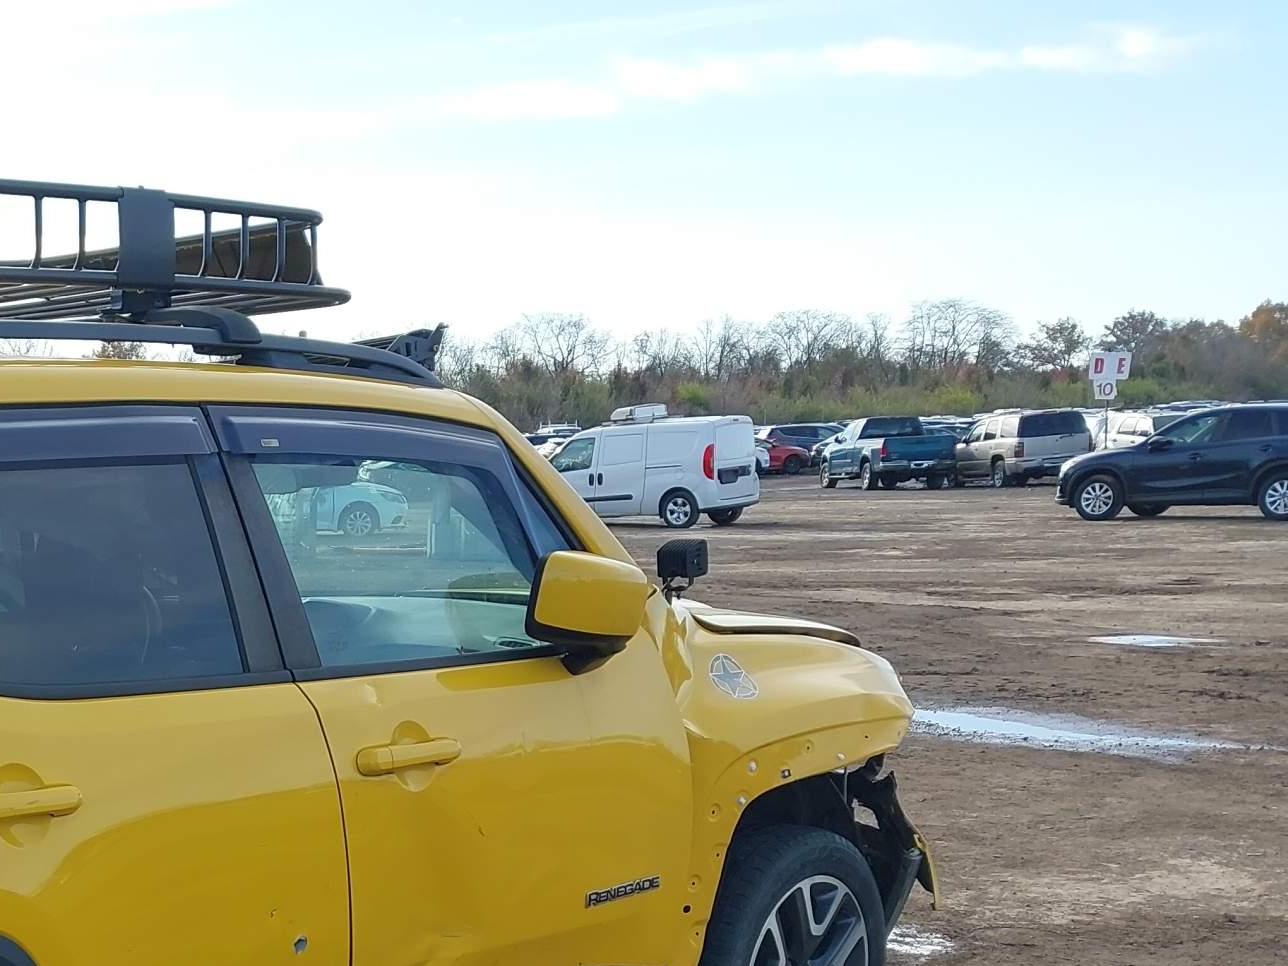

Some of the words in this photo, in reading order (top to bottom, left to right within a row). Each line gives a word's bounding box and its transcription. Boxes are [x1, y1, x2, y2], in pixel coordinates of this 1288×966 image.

[1094, 357, 1104, 375] D
[1116, 357, 1127, 375] E
[1096, 382, 1114, 397] 10
[584, 875, 660, 908] RENEGADE
